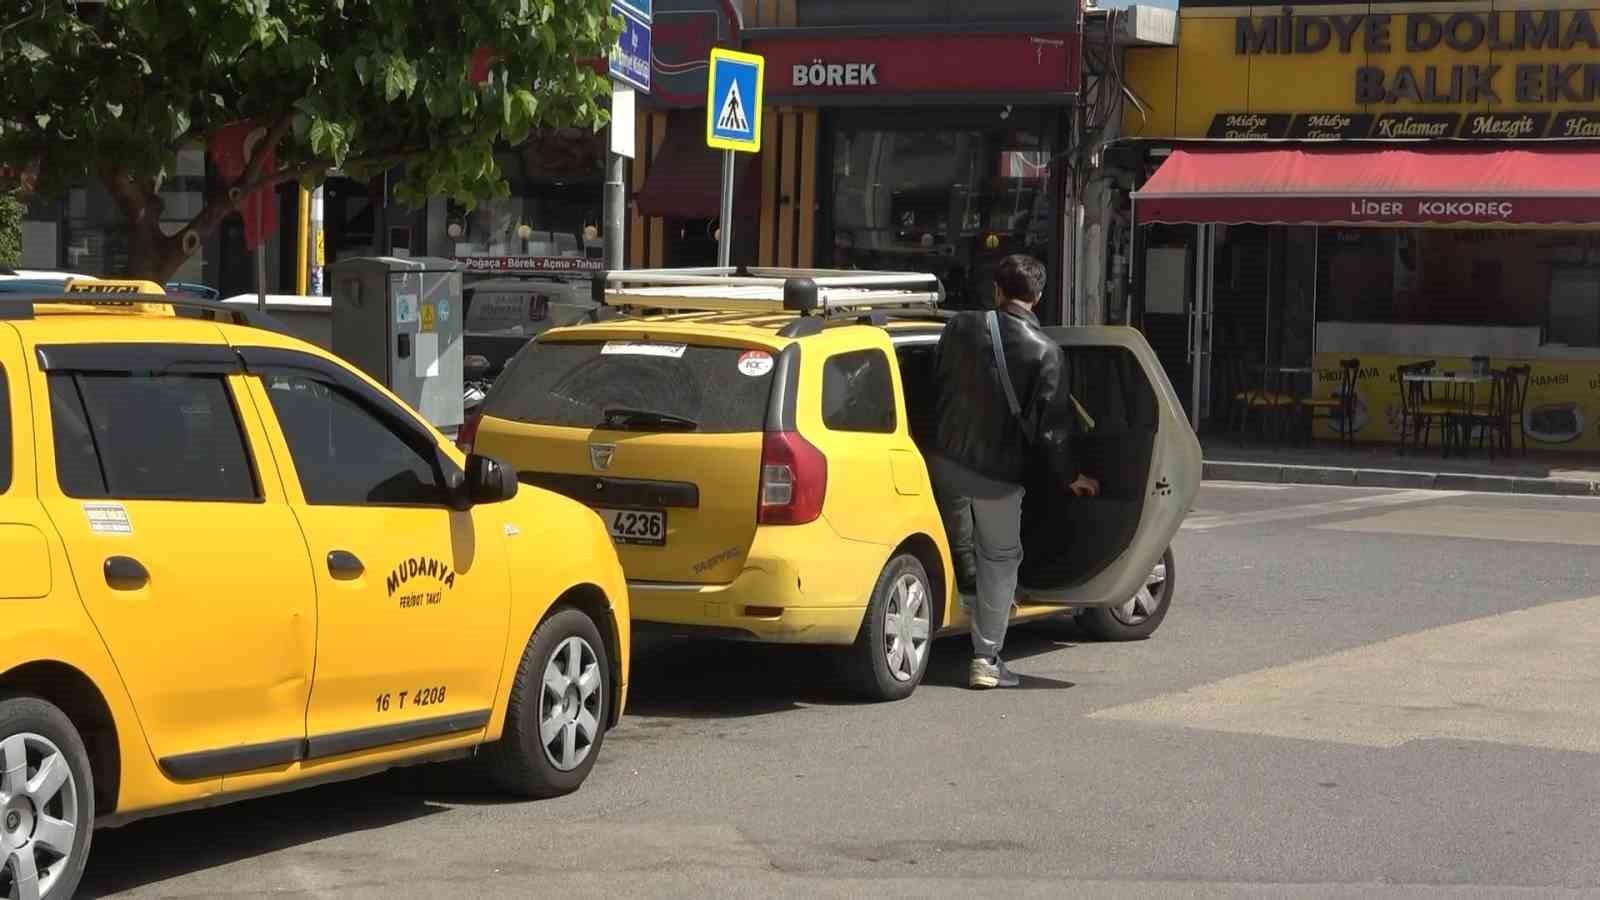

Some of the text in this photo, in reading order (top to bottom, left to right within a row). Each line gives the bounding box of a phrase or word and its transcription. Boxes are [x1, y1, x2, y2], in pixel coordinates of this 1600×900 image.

[1235, 5, 1600, 54] MİDYE DOLMA
[792, 58, 878, 86] BÖREK
[1355, 64, 1501, 104] BALIK
[1225, 114, 1267, 129] Midye
[1308, 114, 1350, 129] Midye
[1379, 116, 1448, 137] Kalamar
[1472, 115, 1534, 137] Mezgit
[1351, 199, 1513, 218] LİDER KOKOREÇ
[466, 258, 500, 270] Poğaça
[508, 258, 536, 268] Börek
[543, 259, 571, 270] Açma
[613, 512, 660, 536] 4236
[386, 556, 455, 597] MUDANYA
[400, 593, 423, 608] FERİBOT
[376, 685, 447, 712] 16 T 4208
